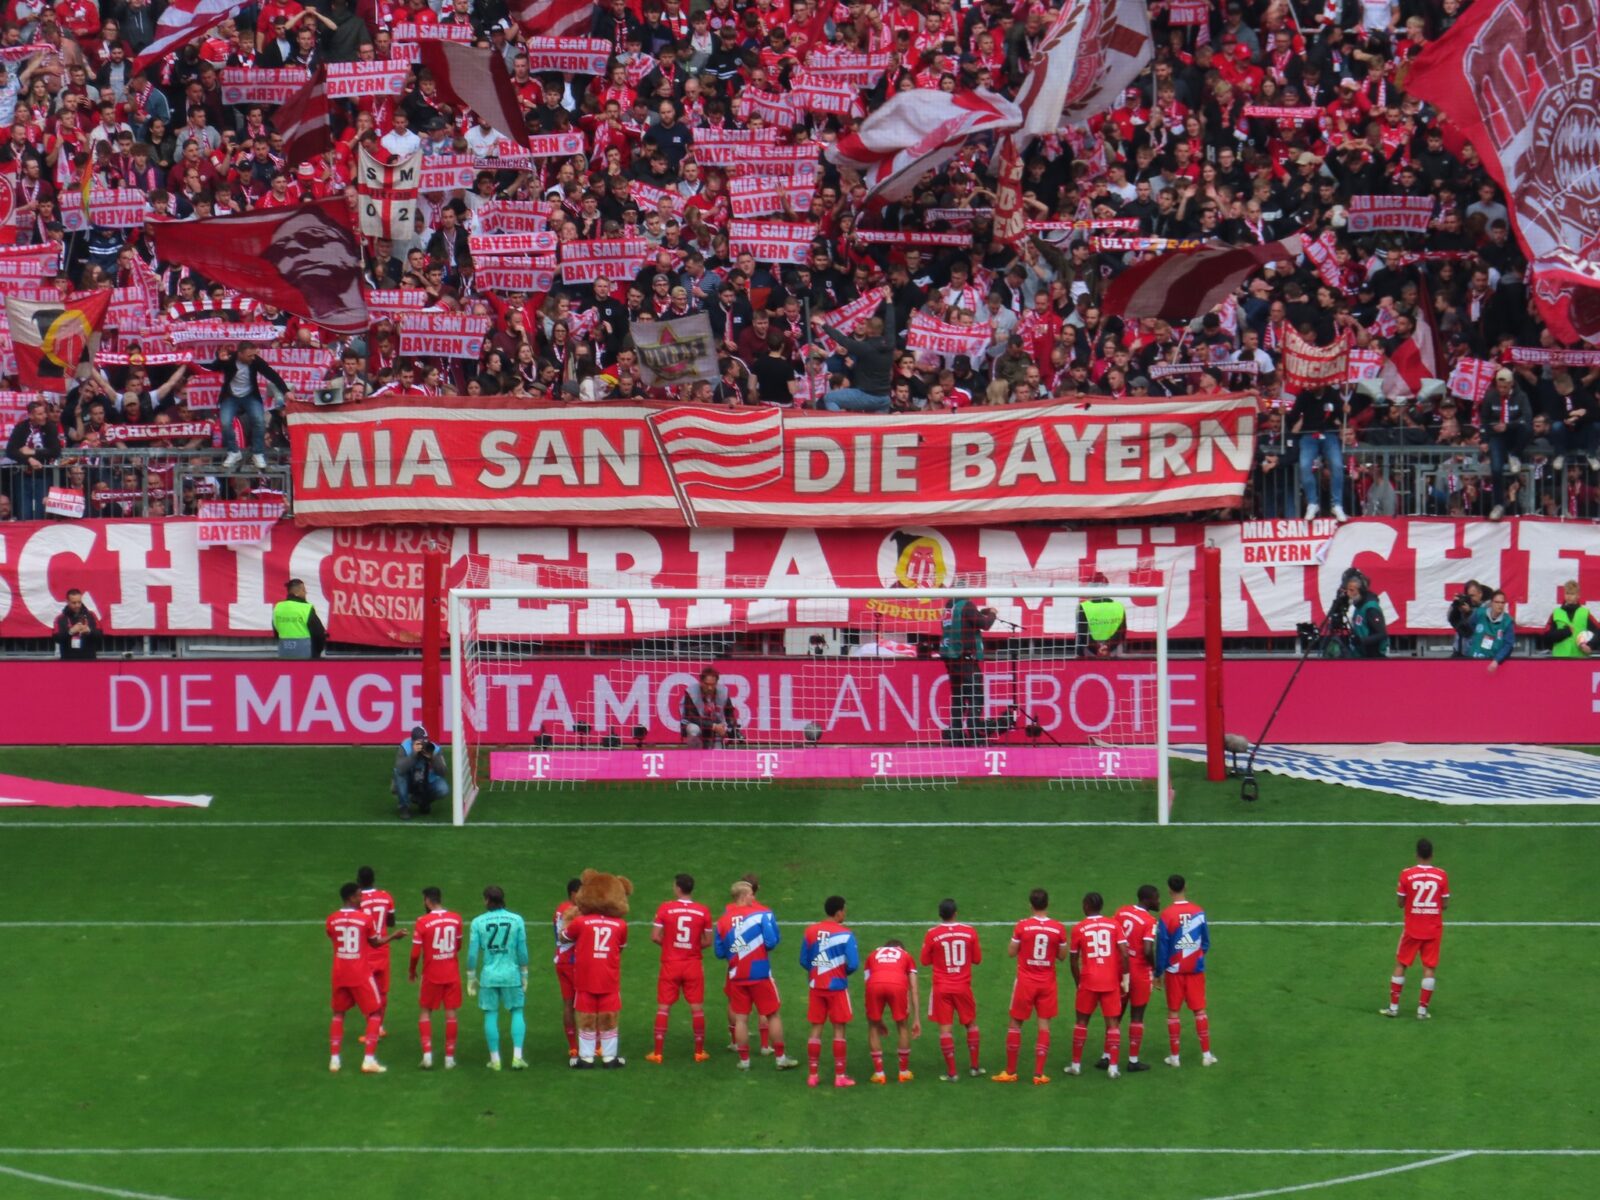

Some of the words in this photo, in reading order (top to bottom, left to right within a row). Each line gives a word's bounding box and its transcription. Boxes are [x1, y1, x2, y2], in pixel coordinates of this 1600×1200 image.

[420, 24, 448, 39] SAN
[531, 36, 557, 49] MIA
[563, 38, 589, 51] SAN
[592, 38, 611, 51] DIE
[327, 61, 353, 75] MIA
[357, 60, 383, 73] SAN
[387, 59, 409, 72] DIE
[530, 55, 588, 71] BAYERN
[327, 77, 385, 95] BAYERN
[693, 128, 720, 141] MIA
[724, 129, 751, 141] SAN
[757, 128, 777, 140] DIE
[499, 137, 559, 156] BAERN
[695, 147, 734, 163] BAYE
[735, 145, 762, 157] MIA
[765, 145, 793, 157] SAN
[796, 145, 818, 157] DIE
[366, 167, 377, 180] S
[400, 167, 413, 182] M
[736, 163, 795, 177] BAYERN
[419, 171, 454, 188] YERN
[731, 178, 758, 193] MIA
[761, 176, 788, 190] SAN
[792, 173, 815, 187] DIE
[398, 208, 409, 221] 2
[482, 215, 535, 232] BAYERN
[730, 222, 757, 237] MIA
[761, 223, 789, 238] SAN
[792, 225, 818, 240] DIE
[856, 231, 905, 242] FORZA
[911, 233, 973, 244] BAYERN
[471, 235, 532, 251] BAYERN
[562, 243, 590, 259] MIA
[593, 242, 621, 256] SAN
[625, 240, 647, 253] DIE
[730, 243, 789, 259] BAYERN
[1101, 238, 1131, 250] ULT
[503, 255, 532, 267] SAN
[476, 272, 533, 289] BAYERN
[564, 262, 626, 281] BAYERN
[370, 290, 399, 305] SAN
[403, 290, 427, 306] DIE
[402, 312, 430, 331] MIA
[433, 316, 461, 332] SAN
[465, 318, 488, 334] DIE
[401, 337, 463, 355] BAYERN
[908, 331, 968, 354] BAYERN
[145, 351, 193, 362] KERIA
[282, 349, 311, 364] SAN
[190, 391, 220, 407] BAY
[105, 422, 212, 442] SCHICKERIA
[302, 429, 453, 490] MIA
[478, 428, 643, 491] SAN
[793, 433, 920, 494] DIE
[949, 415, 1254, 493] BAYERN
[230, 503, 259, 518] SAN
[200, 526, 262, 542] BAYERN
[1242, 521, 1275, 540] MIA
[1277, 519, 1308, 538] SAN
[1311, 518, 1337, 537] DIE
[336, 527, 452, 554] ULTRAS
[1244, 544, 1311, 563] BAYERN
[332, 589, 448, 622] RASSISMS
[109, 674, 213, 733] DIE
[528, 753, 550, 778] T
[642, 753, 664, 778] T
[756, 752, 778, 777] T
[870, 752, 893, 776] T
[984, 751, 1007, 776] T
[1098, 751, 1121, 776] T
[1412, 880, 1438, 908] 22
[676, 916, 692, 943] 5
[1179, 913, 1191, 929] T
[335, 925, 360, 954] 38
[432, 925, 456, 953] 40
[485, 922, 512, 951] 27
[593, 926, 612, 952] 12
[817, 930, 831, 946] T
[1084, 929, 1112, 959] 39
[941, 939, 967, 967] 10
[1033, 933, 1049, 960] 8
